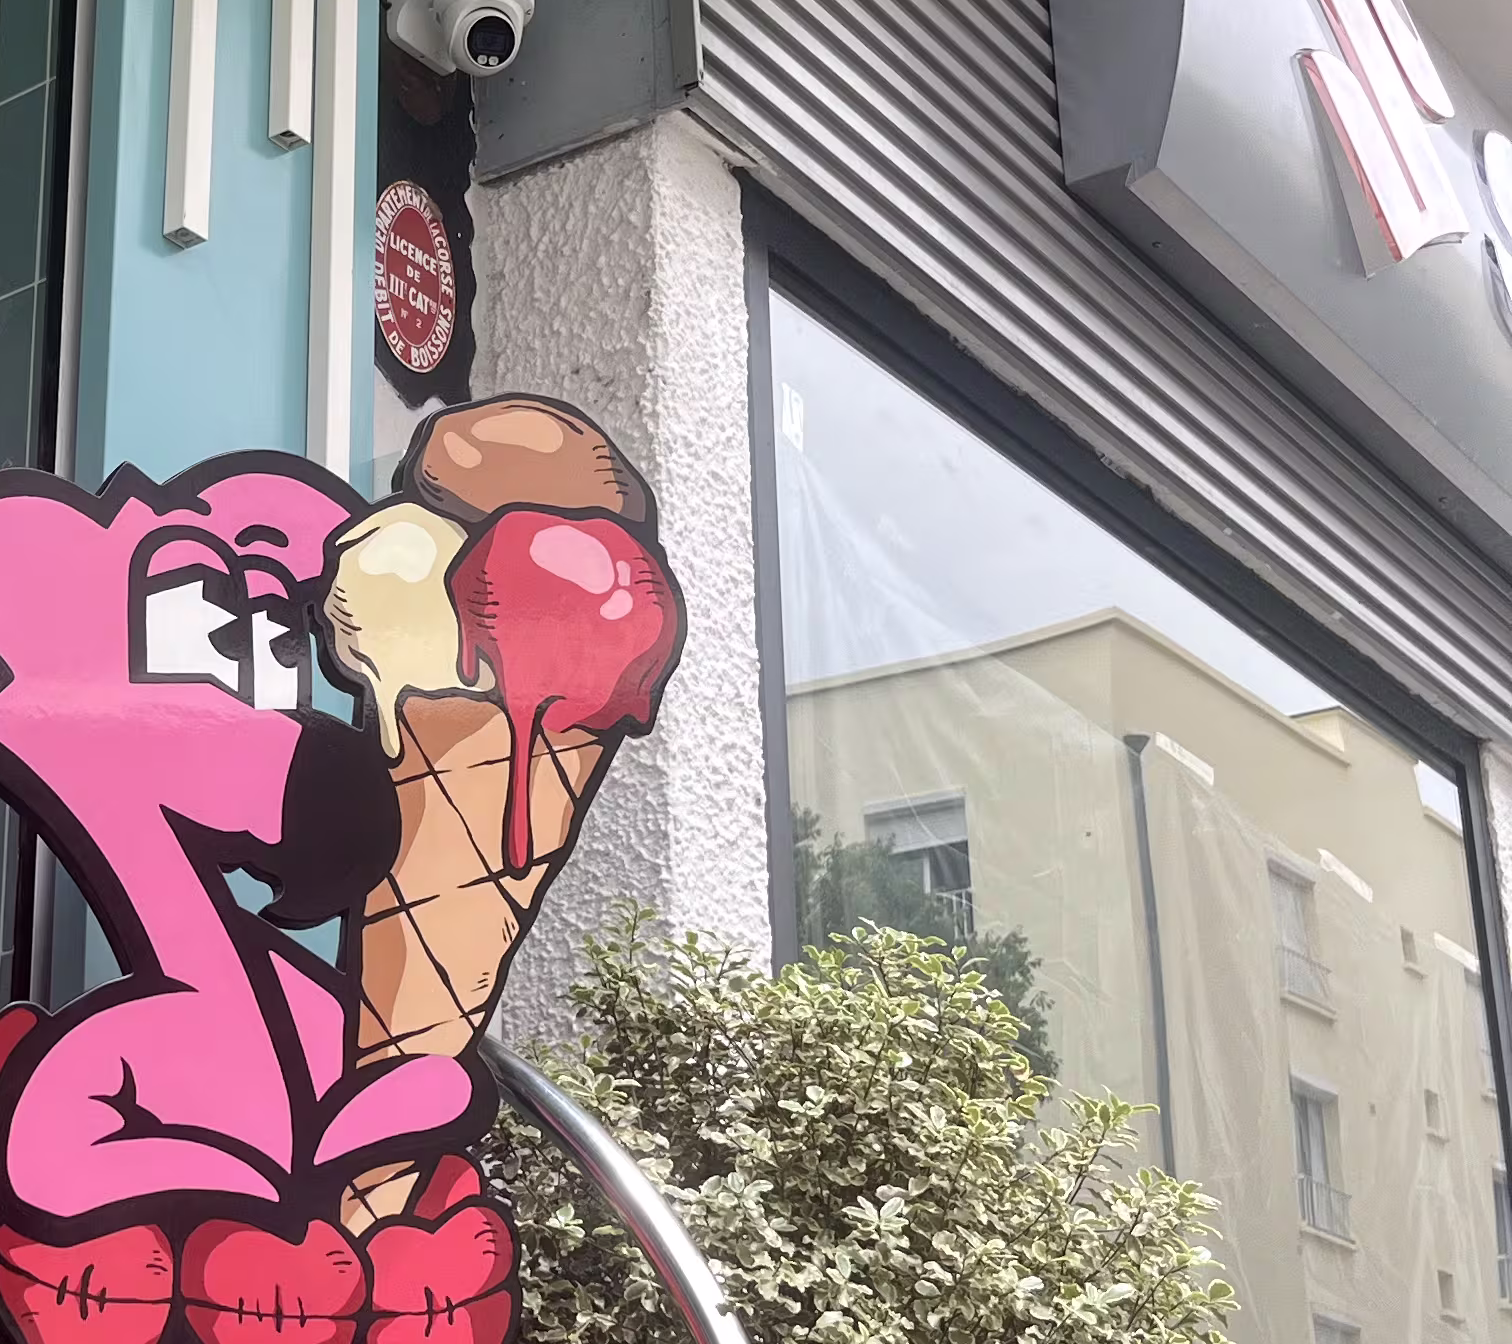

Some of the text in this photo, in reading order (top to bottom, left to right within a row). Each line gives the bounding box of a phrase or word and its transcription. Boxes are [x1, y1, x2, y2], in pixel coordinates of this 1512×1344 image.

[389, 231, 437, 276] LICENCE
[406, 264, 420, 283] DE
[429, 222, 440, 237] LA
[435, 236, 453, 298] CORSE
[375, 260, 452, 368] DEBIT DE BOISSONS
[415, 318, 422, 329] 2
